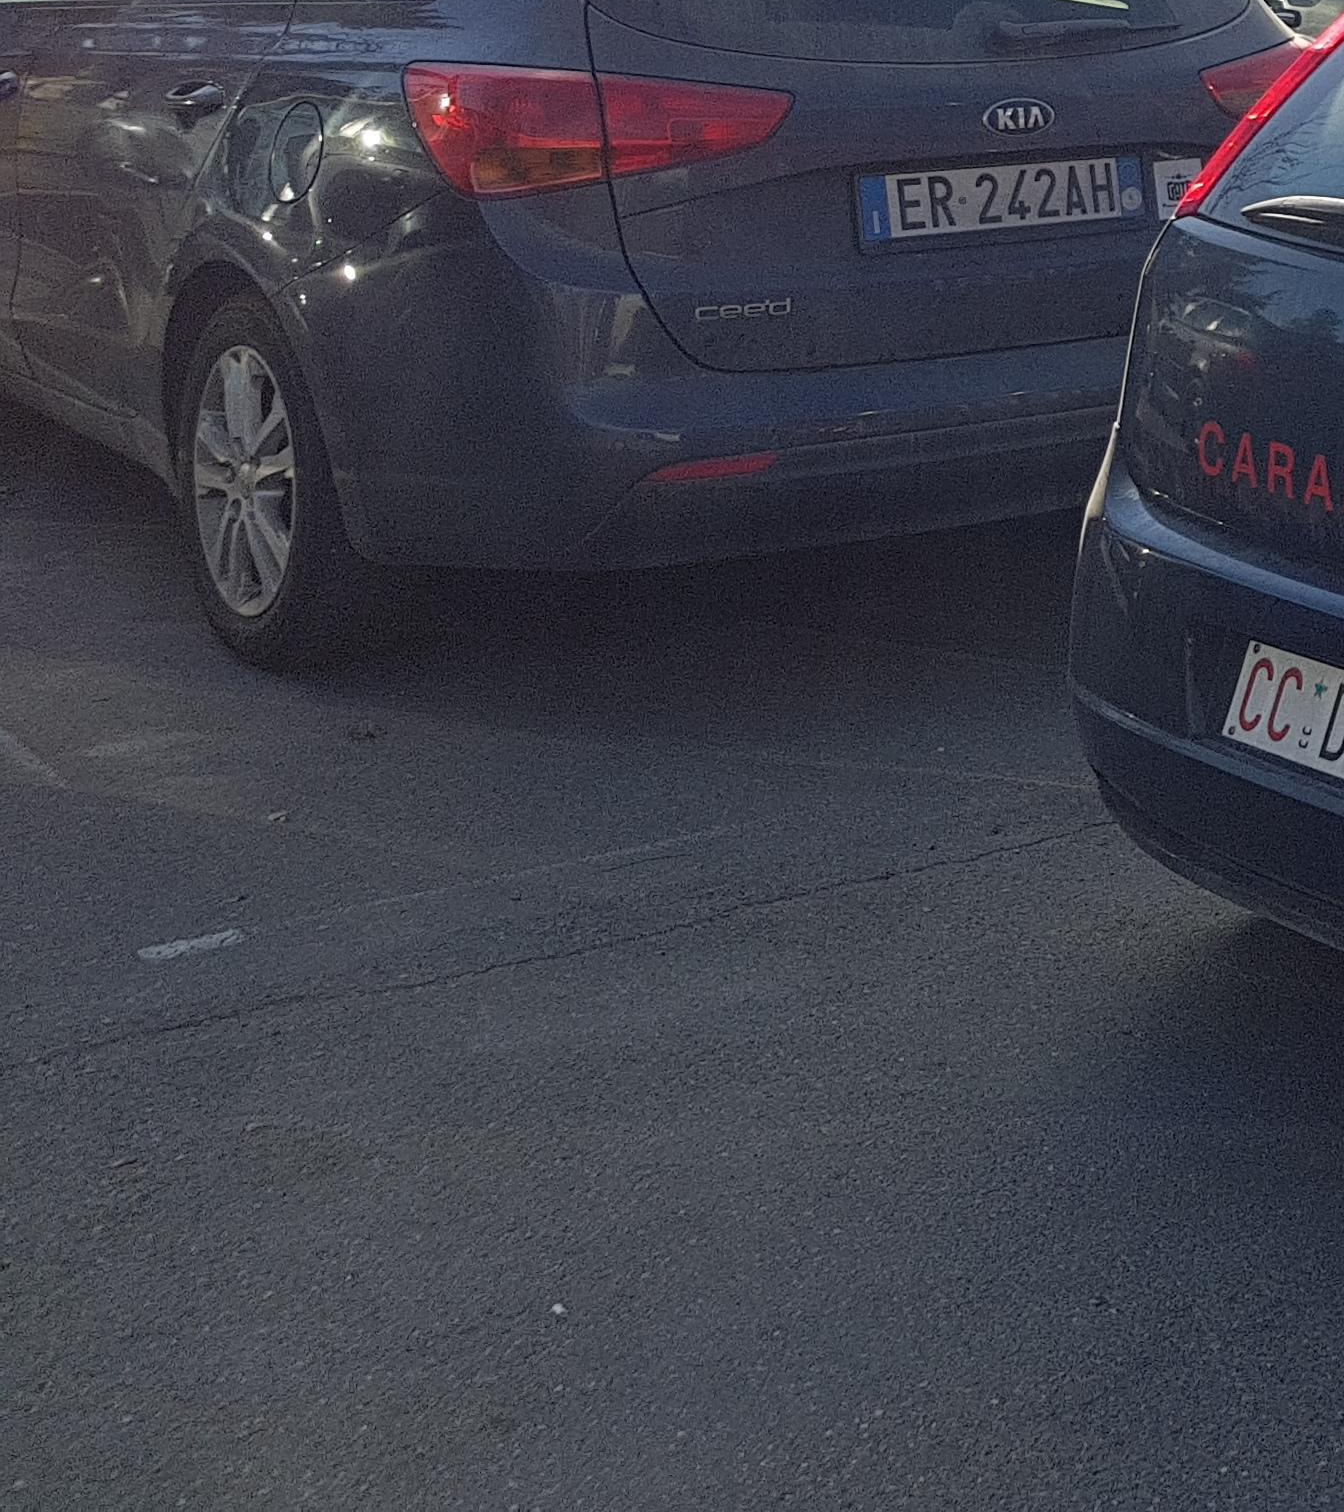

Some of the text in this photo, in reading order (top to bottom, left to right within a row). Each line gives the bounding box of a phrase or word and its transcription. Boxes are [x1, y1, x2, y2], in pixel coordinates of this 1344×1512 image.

[996, 106, 1046, 130] KIA
[896, 175, 957, 231] ER
[975, 162, 1117, 225] 242AH
[1238, 657, 1303, 742] CC
